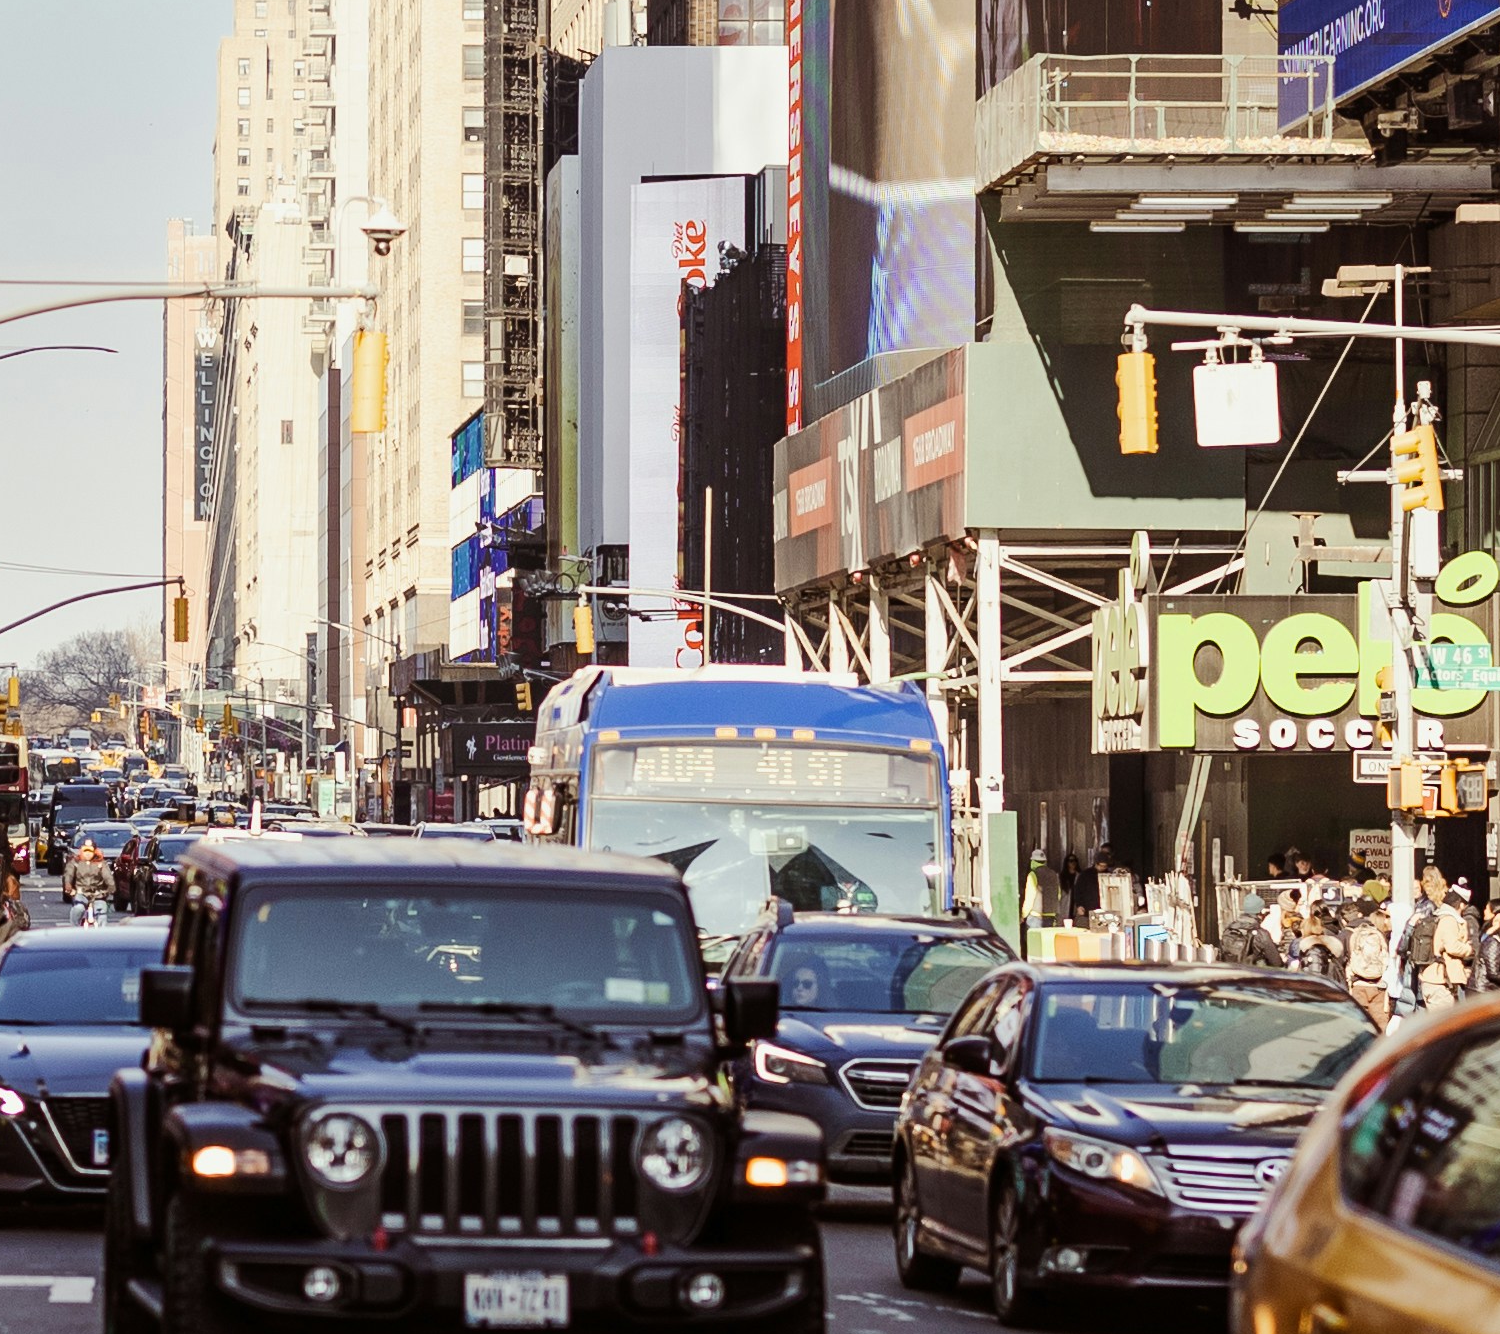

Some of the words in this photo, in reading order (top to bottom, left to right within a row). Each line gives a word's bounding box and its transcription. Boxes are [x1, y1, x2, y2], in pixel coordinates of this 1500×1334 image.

[1433, 648, 1446, 665] W
[1453, 647, 1473, 665] 46
[1478, 647, 1488, 659] St
[1233, 719, 1445, 750] SOCCR
[1355, 835, 1391, 845] PARTIAL
